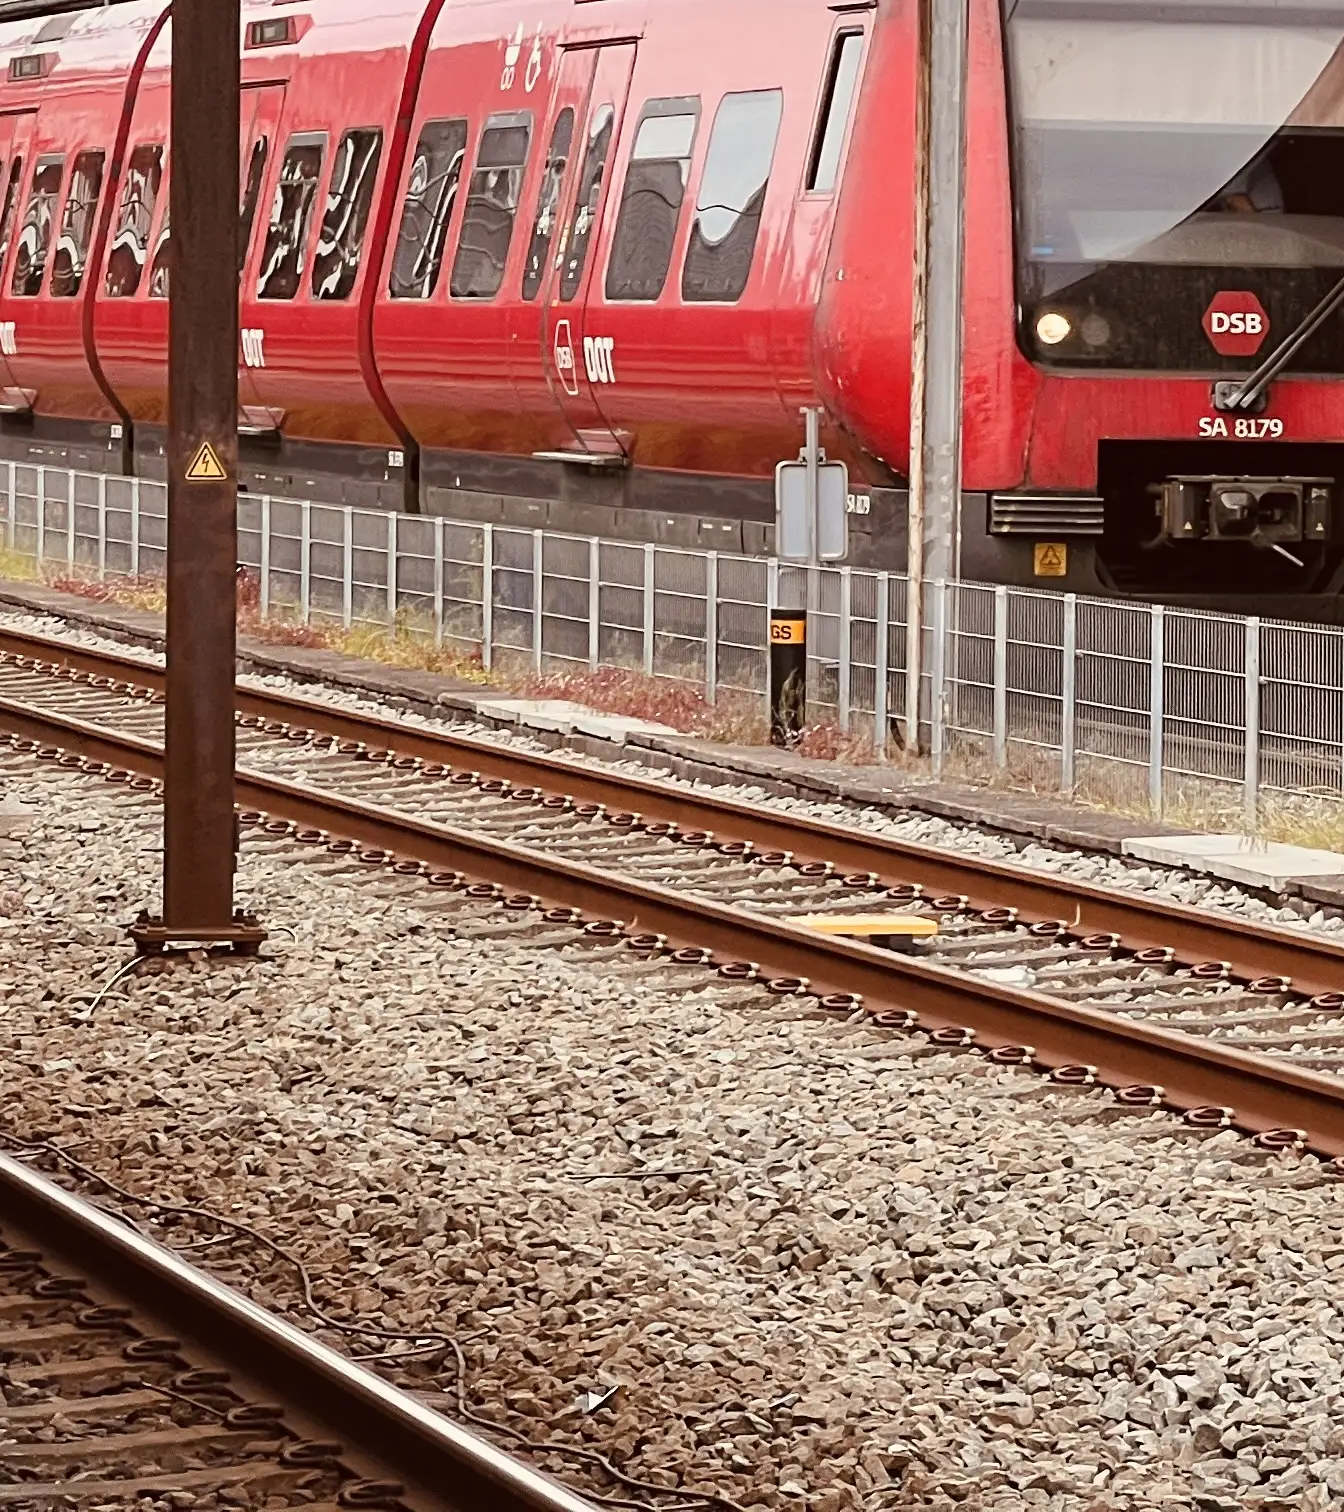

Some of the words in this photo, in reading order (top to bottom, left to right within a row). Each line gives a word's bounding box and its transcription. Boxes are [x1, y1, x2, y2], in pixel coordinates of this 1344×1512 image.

[1211, 312, 1262, 334] DSB
[583, 336, 615, 383] DOT
[1199, 417, 1228, 437] SA
[1234, 418, 1283, 438] 8179
[771, 624, 792, 640] GS
